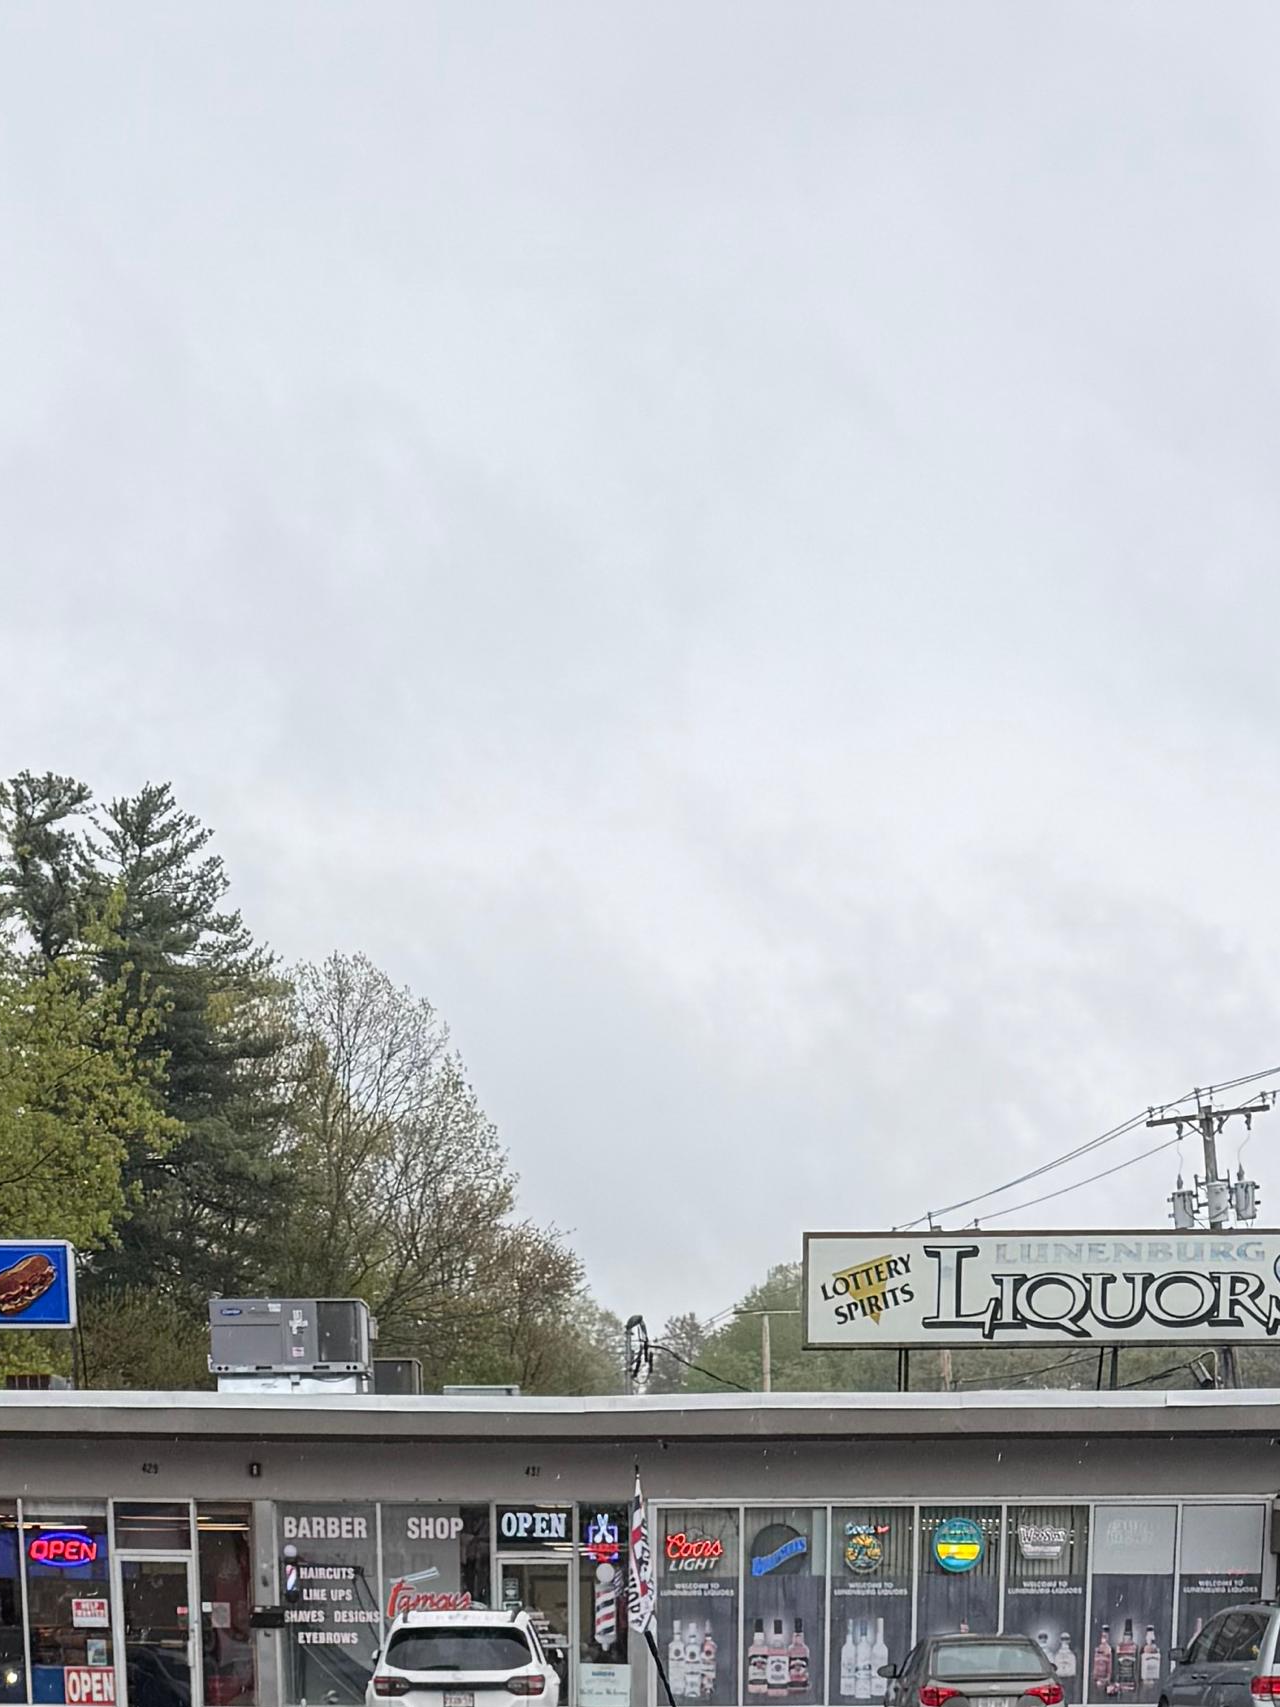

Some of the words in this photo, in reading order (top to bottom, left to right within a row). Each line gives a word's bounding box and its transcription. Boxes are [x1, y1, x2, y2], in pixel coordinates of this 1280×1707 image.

[995, 1241, 1266, 1264] LUNENBURG
[820, 1253, 912, 1301] LOTTERY
[834, 1283, 914, 1325] SPIRITS
[283, 1516, 368, 1539] BARBER
[406, 1517, 465, 1539] SHOP
[501, 1511, 567, 1538] OPEN
[29, 1539, 98, 1561] OPEN
[666, 1533, 723, 1558] Coors
[300, 1567, 356, 1580] HAIRCUTS
[669, 1557, 719, 1572] LIGHT
[302, 1588, 327, 1601] LINE
[330, 1588, 353, 1601] UPS
[284, 1610, 325, 1623] SHAVES
[333, 1610, 380, 1623] DESIGNS
[298, 1632, 359, 1644] EYEBROWS
[69, 1671, 115, 1702] OPEN
